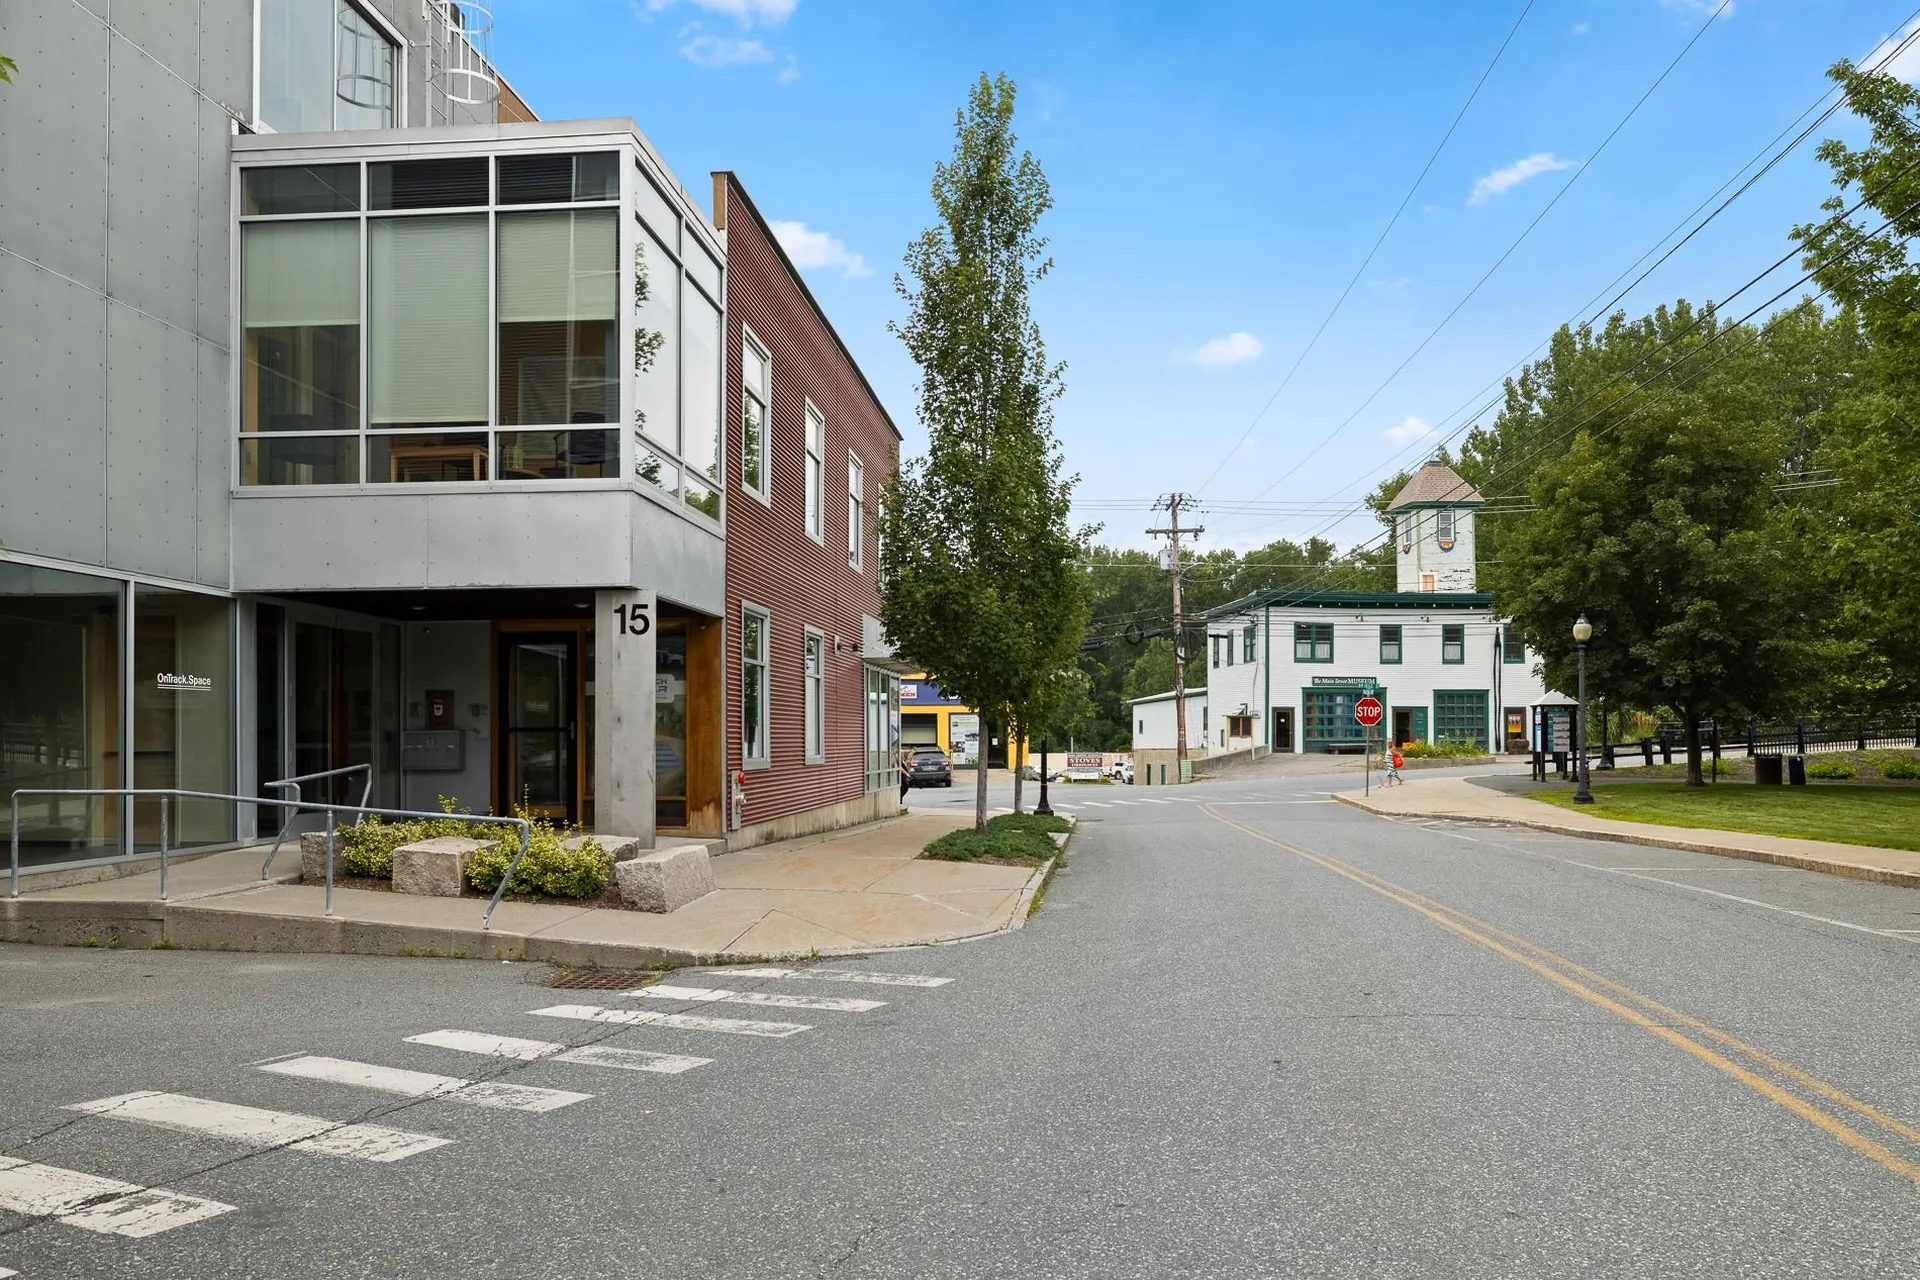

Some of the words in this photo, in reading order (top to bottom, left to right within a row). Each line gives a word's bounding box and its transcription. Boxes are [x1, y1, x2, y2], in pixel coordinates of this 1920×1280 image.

[613, 603, 650, 635] 15
[157, 673, 211, 686] OnTrack.Space
[1357, 706, 1380, 717] STOP
